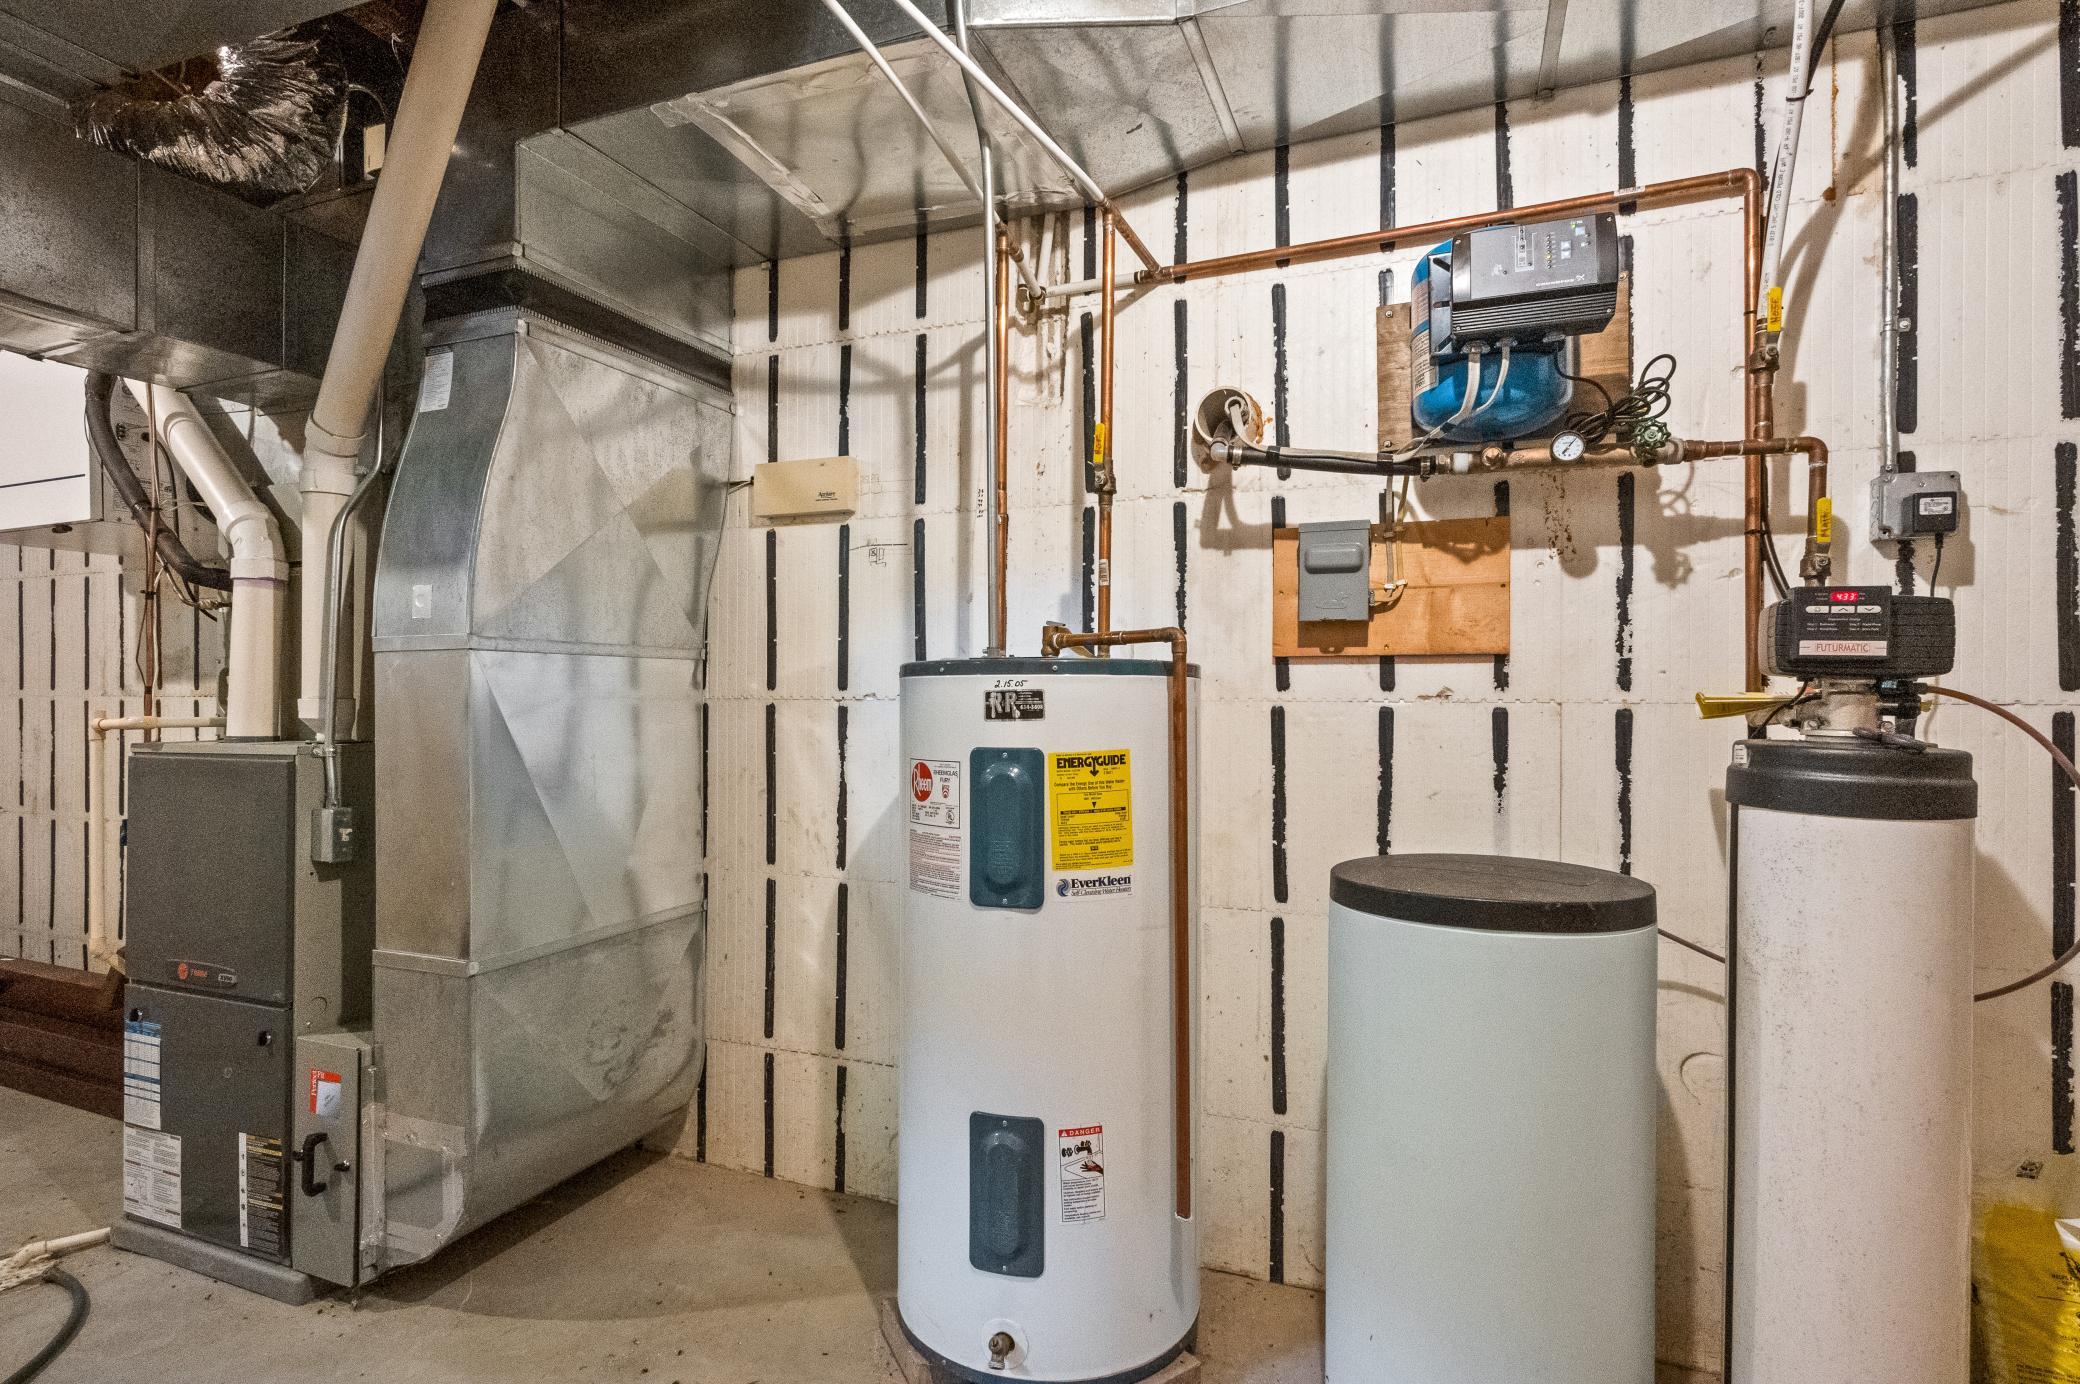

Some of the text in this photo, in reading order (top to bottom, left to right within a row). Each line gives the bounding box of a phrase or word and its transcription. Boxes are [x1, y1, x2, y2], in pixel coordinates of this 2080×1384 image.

[1816, 642, 1869, 653] FUTURMATIC
[1056, 754, 1126, 769] ENERGYGUIDE
[1071, 875, 1131, 889] EverKleen
[1069, 1127, 1101, 1136] DANGER
